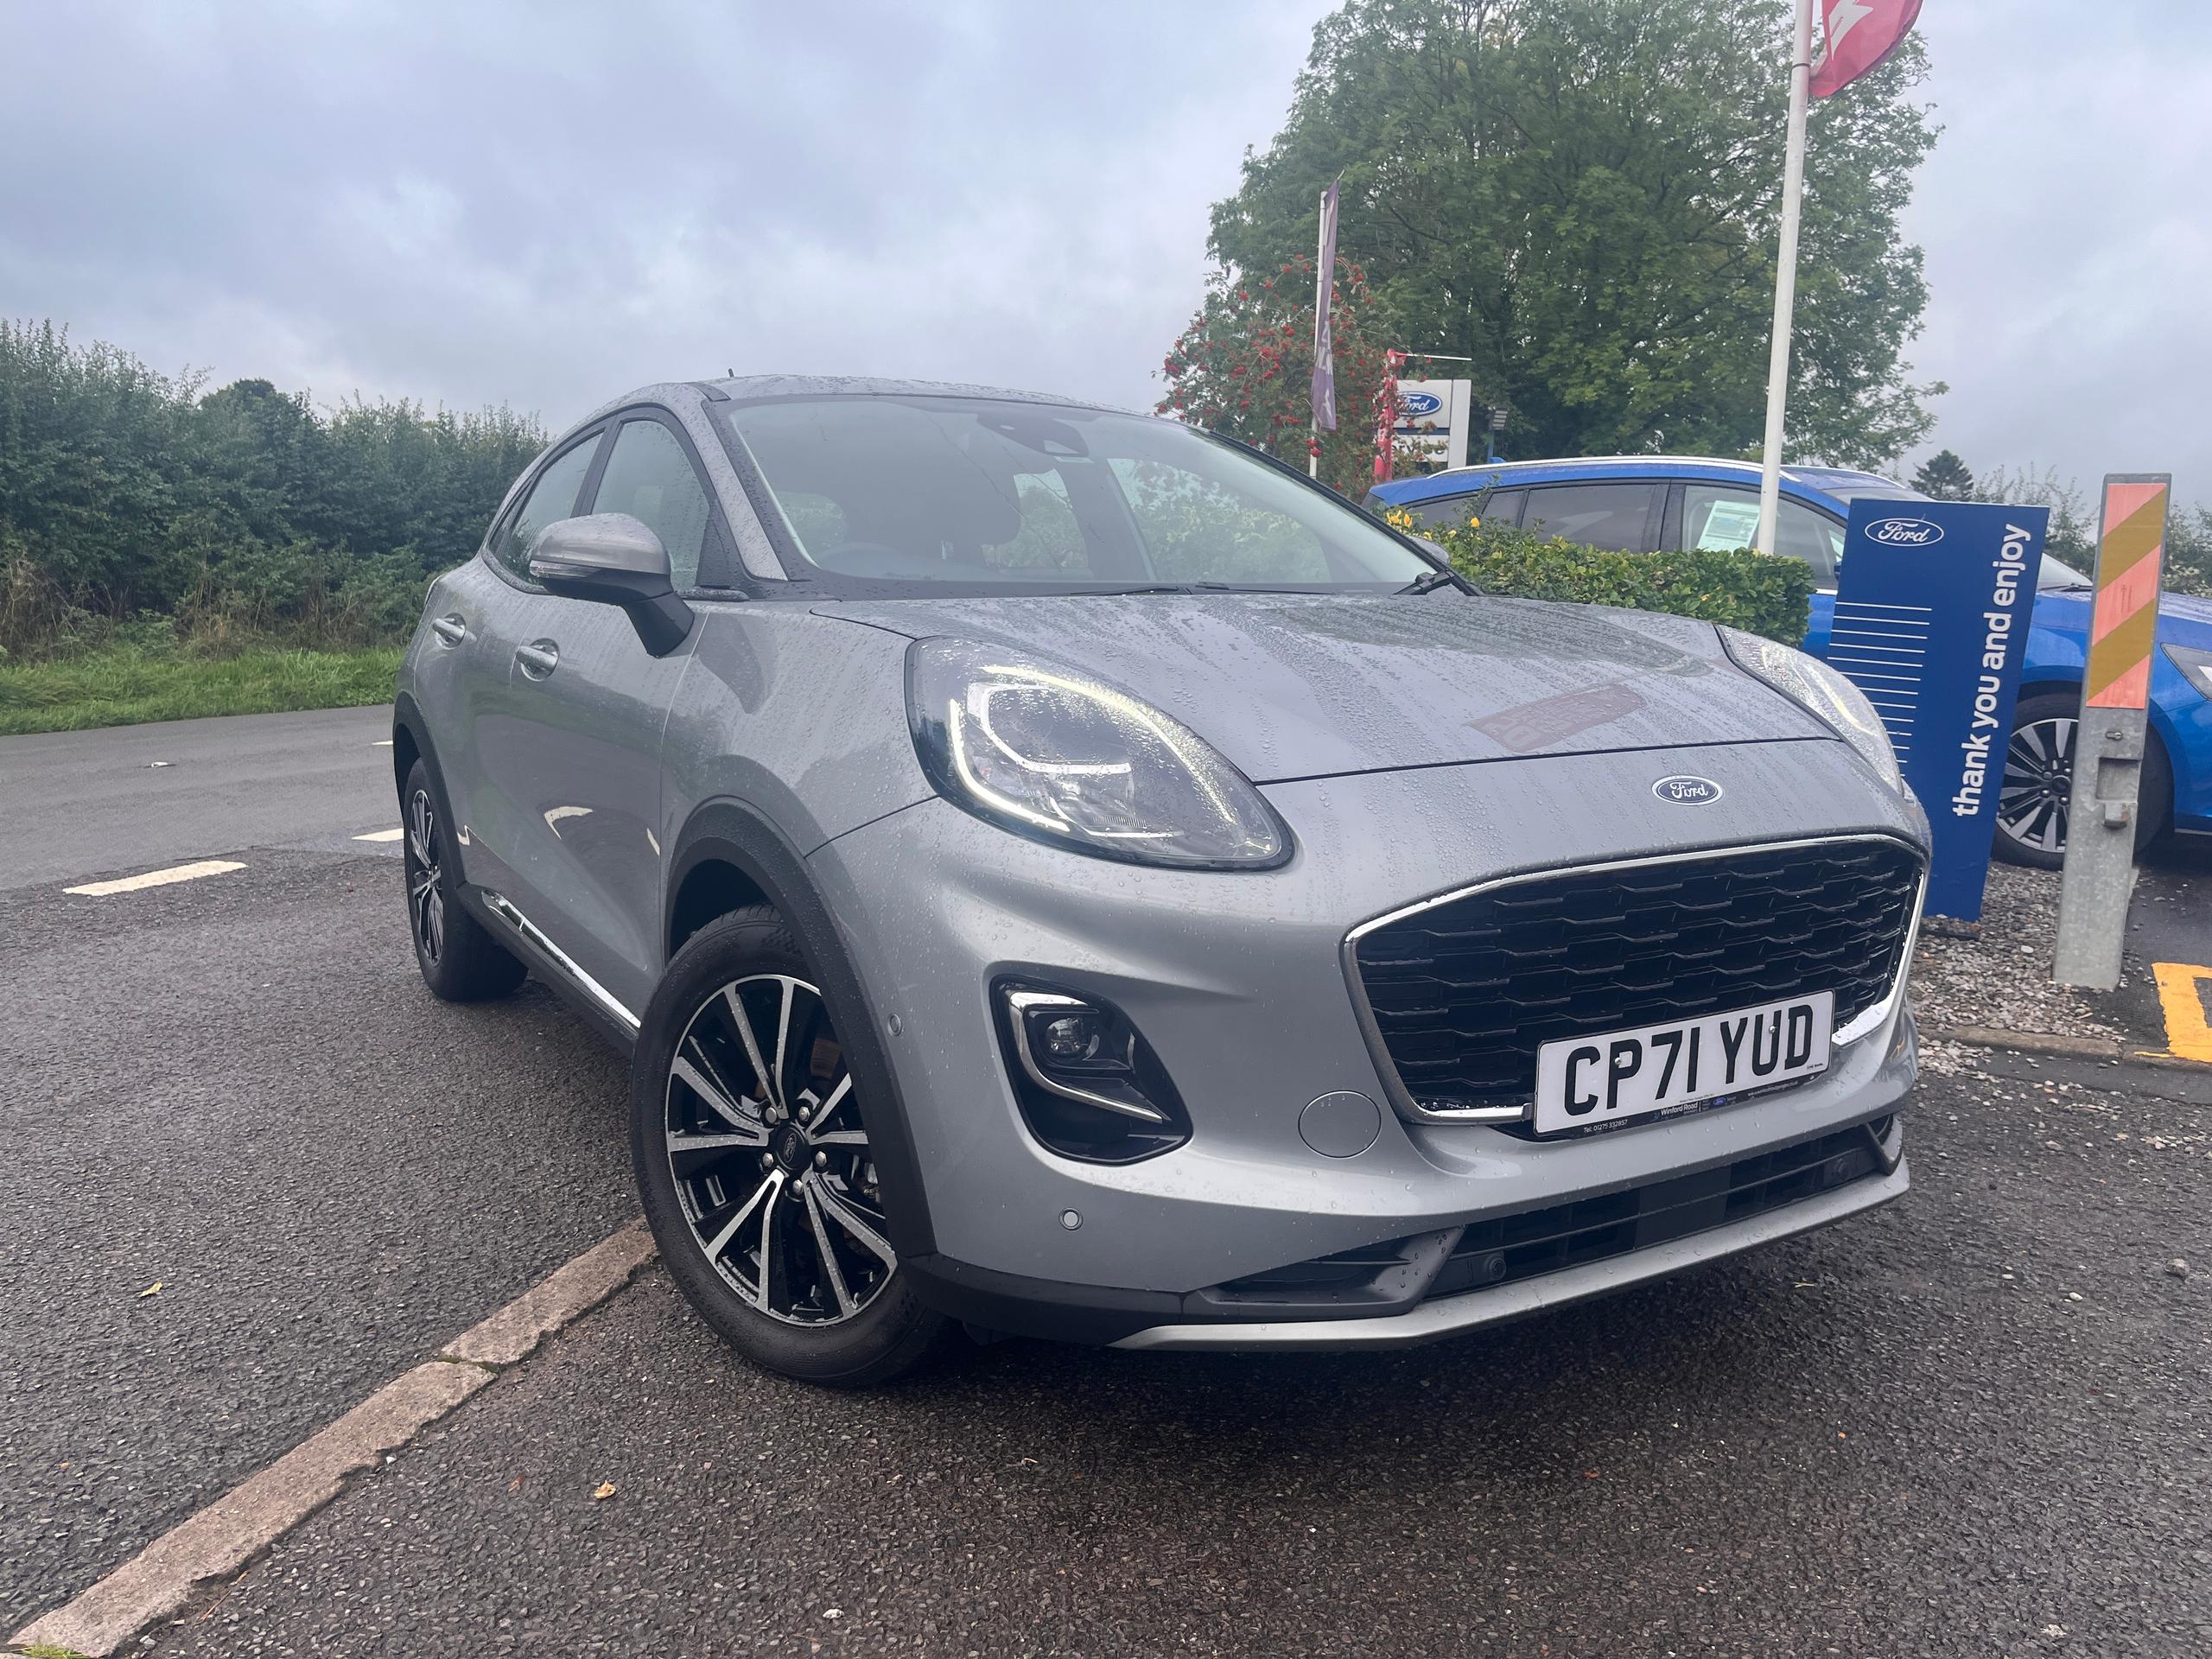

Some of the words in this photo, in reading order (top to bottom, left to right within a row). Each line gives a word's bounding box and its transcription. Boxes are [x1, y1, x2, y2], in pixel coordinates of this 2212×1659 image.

[1878, 521, 1930, 543] Ford
[1993, 524, 2031, 607] enjoy
[1982, 612, 2012, 670] and
[1972, 675, 1999, 728] you
[1669, 781, 1708, 798] Ford
[1952, 734, 1991, 817] thank
[1564, 1027, 1700, 1116] CP71
[1720, 1004, 1814, 1084] YUD
[1661, 1104, 1683, 1116] Winford
[1683, 1101, 1699, 1111] Road
